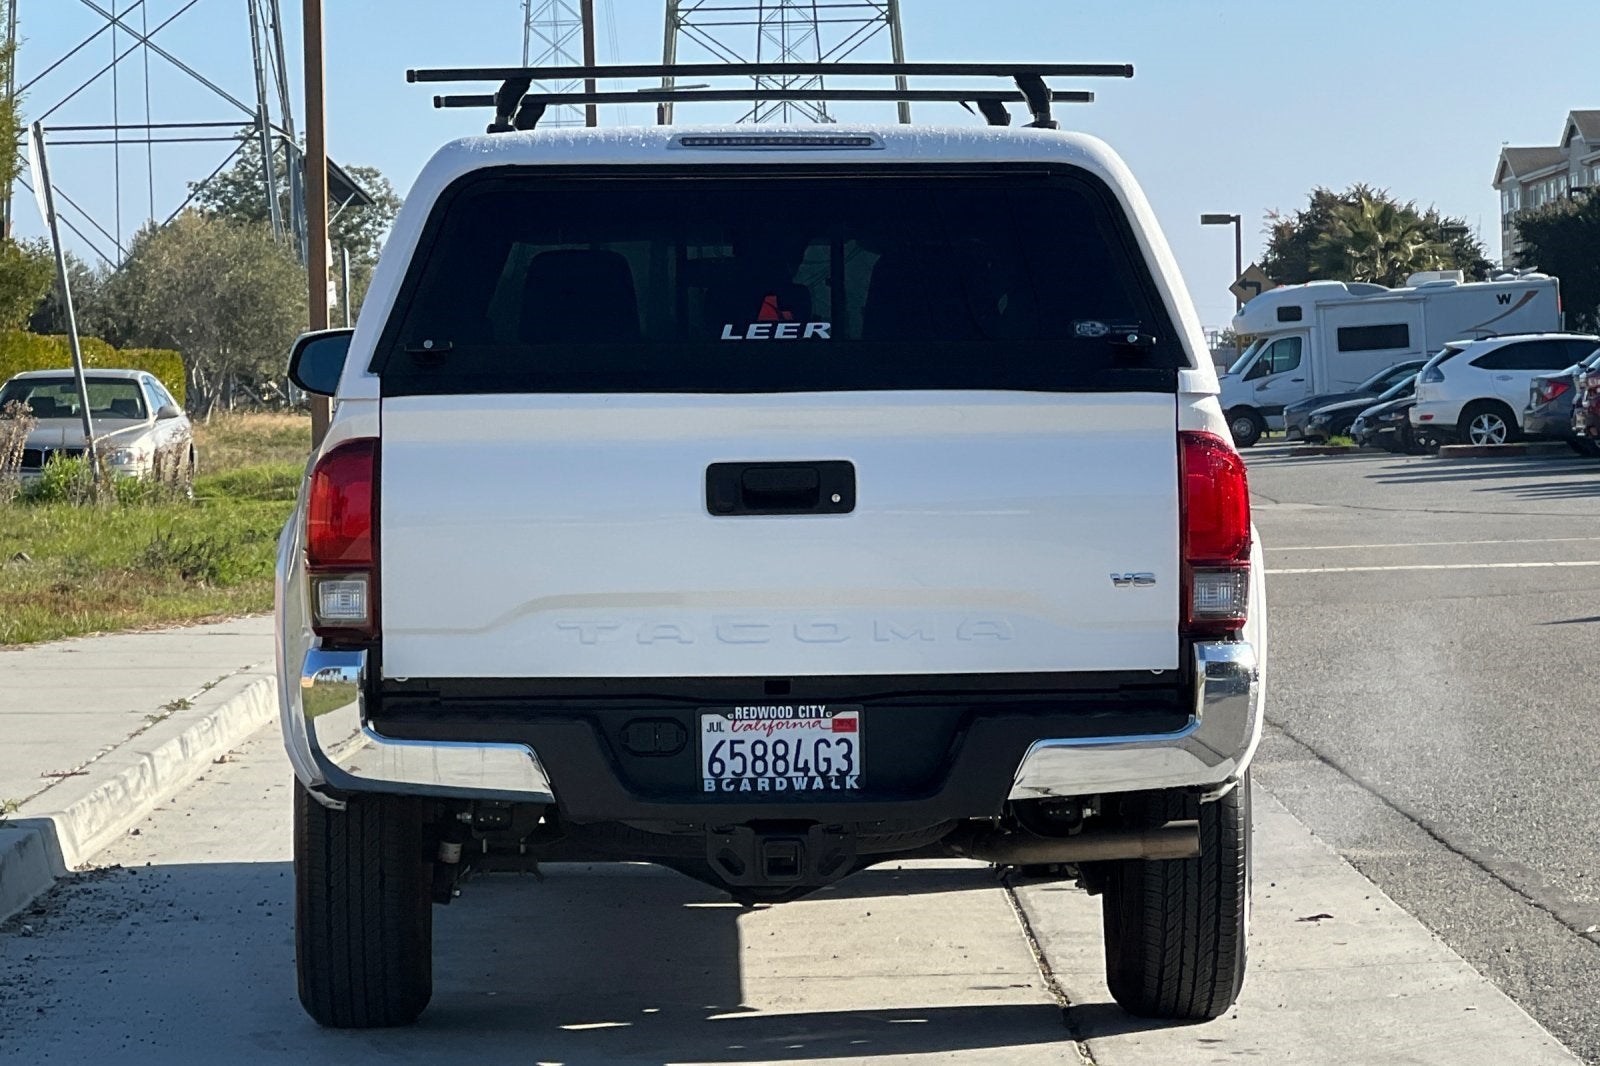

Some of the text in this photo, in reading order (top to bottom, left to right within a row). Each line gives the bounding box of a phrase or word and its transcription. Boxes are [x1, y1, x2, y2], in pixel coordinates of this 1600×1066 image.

[720, 322, 831, 340] LEER
[556, 617, 1015, 645] TACOMA
[735, 705, 826, 720] REDWOOD CITY
[706, 721, 725, 733] JUL
[731, 719, 832, 737] California
[707, 738, 853, 778] 65884G3
